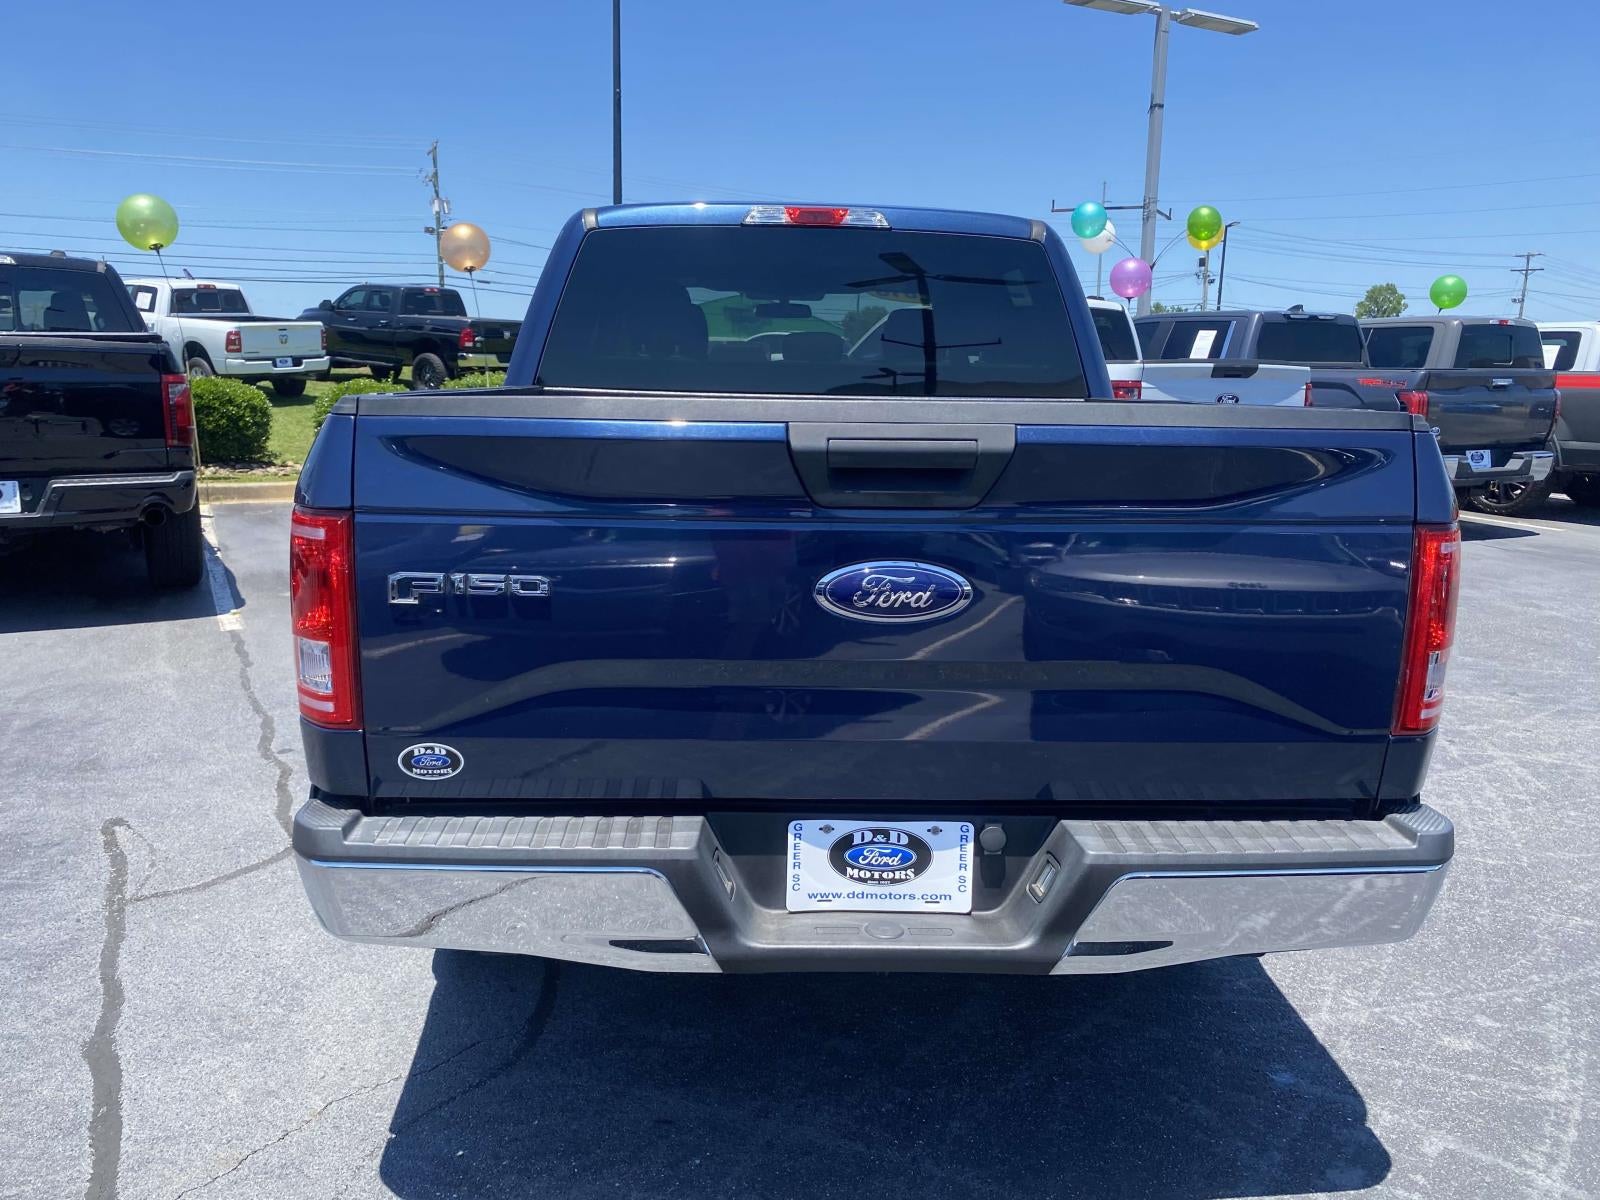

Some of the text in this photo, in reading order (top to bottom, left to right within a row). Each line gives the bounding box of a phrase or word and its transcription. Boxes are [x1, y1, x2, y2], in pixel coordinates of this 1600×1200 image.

[853, 574, 937, 608] Ford
[413, 747, 447, 756] D&D
[419, 757, 444, 767] Ford
[412, 767, 453, 775] MOTORS
[852, 830, 909, 846] D&D
[792, 822, 803, 892] GREER SC
[858, 847, 903, 866] Ford
[958, 824, 969, 893] GREER SC
[846, 866, 915, 881] MOTORS
[807, 890, 952, 901] www.ddmotors.com
